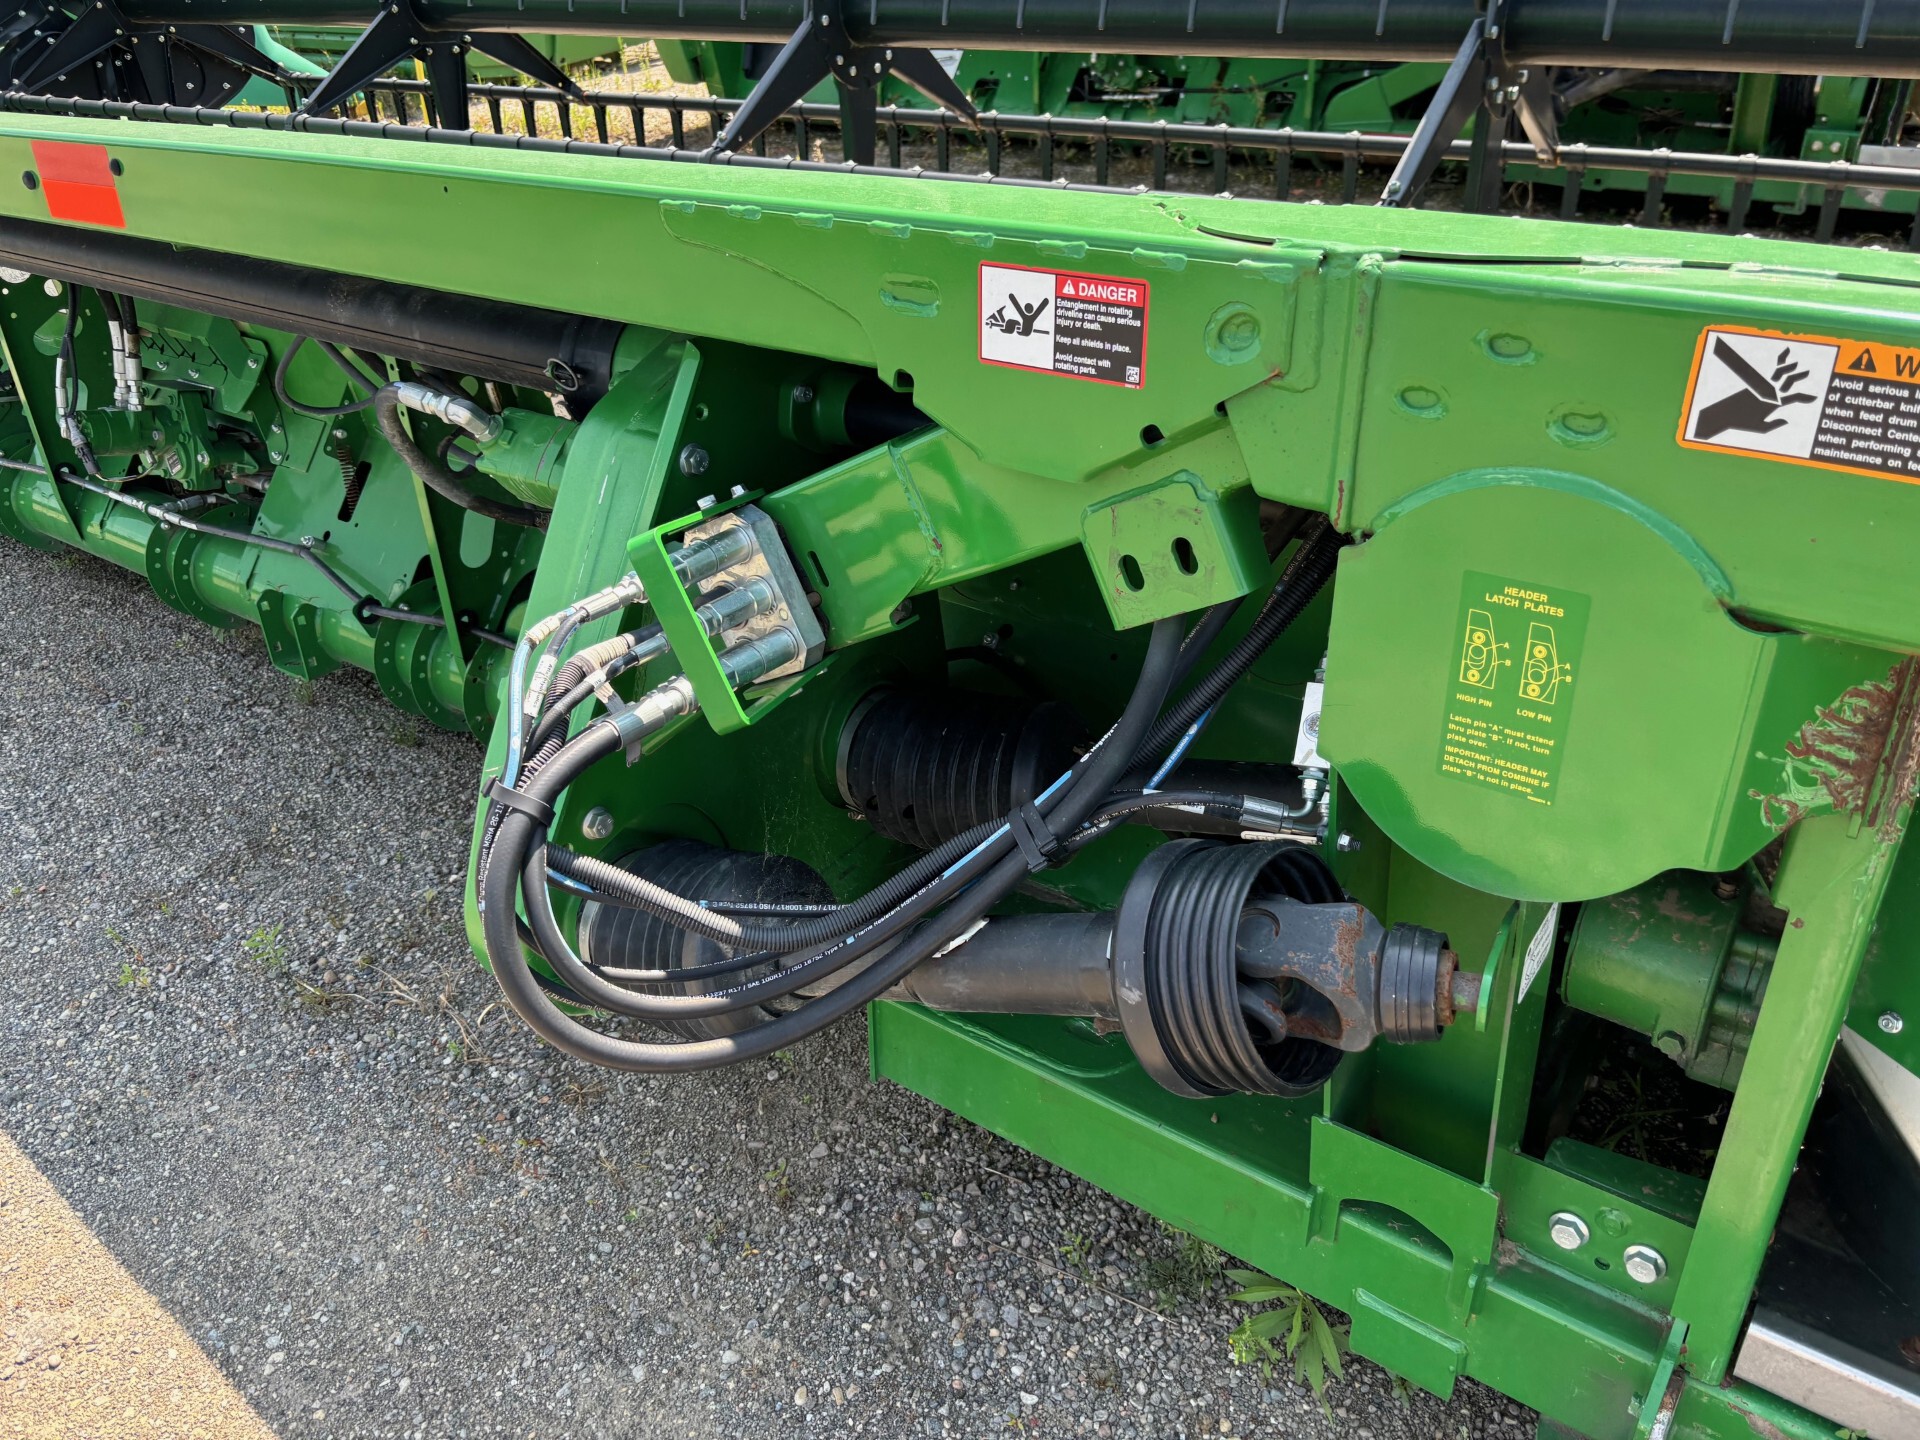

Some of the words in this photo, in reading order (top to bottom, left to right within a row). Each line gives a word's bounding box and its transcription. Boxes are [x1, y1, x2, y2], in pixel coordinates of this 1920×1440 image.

[1078, 283, 1137, 302] DANGER
[1056, 308, 1083, 319] driveline
[1084, 312, 1095, 320] can
[1097, 314, 1115, 323] cause
[1117, 316, 1141, 327] serious
[1057, 299, 1099, 312] Entanglement
[1108, 305, 1133, 318] rotating
[1056, 318, 1074, 329] injury
[1083, 320, 1102, 331] death.
[1056, 335, 1071, 346] Keep
[1081, 339, 1103, 349] shields
[1105, 342, 1110, 350] in
[1112, 343, 1131, 354] place.
[1055, 352, 1073, 362] Avoid
[1074, 355, 1096, 366] contact
[1098, 358, 1112, 368] with
[1055, 362, 1078, 374] rotating
[1079, 366, 1097, 375] parts.
[1832, 378, 1863, 392] Avoid
[1869, 384, 1909, 398] serious
[1829, 392, 1840, 403] of
[1845, 395, 1895, 410] cutterbar
[1825, 406, 1853, 418] when
[1859, 410, 1882, 423] feed
[1889, 415, 1917, 428] drum
[1821, 419, 1882, 437] Disconnect
[1818, 433, 1846, 445] when
[1851, 439, 1911, 457] performing
[1814, 447, 1882, 465] maintenance
[1888, 459, 1902, 468] on
[1504, 586, 1548, 603] HEADER
[1485, 593, 1519, 608] LATCH
[1524, 602, 1564, 617] PLATES
[1456, 693, 1477, 705] HIGH
[1479, 698, 1492, 708] PIN
[1517, 708, 1535, 719] LOW
[1537, 713, 1552, 723] PIN
[1449, 723, 1465, 733] thru
[1466, 728, 1487, 739] plate
[1532, 744, 1549, 755] turn
[1450, 713, 1472, 725] Latch
[1474, 720, 1486, 730] pin
[1488, 723, 1503, 732] "A"
[1504, 727, 1525, 737] must
[1526, 732, 1554, 746] extend
[1447, 732, 1467, 745] plate
[1469, 738, 1488, 749] over.
[1445, 745, 1493, 764] IMPORTANT:
[1495, 758, 1529, 773] HEADER
[1531, 766, 1548, 778] MAY
[1442, 764, 1462, 776] plate
[1478, 772, 1484, 780] is
[1486, 774, 1499, 784] not
[1501, 779, 1508, 787] in
[1510, 782, 1533, 795] place.
[1444, 755, 1475, 769] DETACH
[1477, 763, 1500, 775] FROM
[1502, 769, 1540, 785] COMBINE
[1542, 779, 1550, 788] IF
[483, 827, 495, 848] MSHA
[747, 981, 760, 989] SAE
